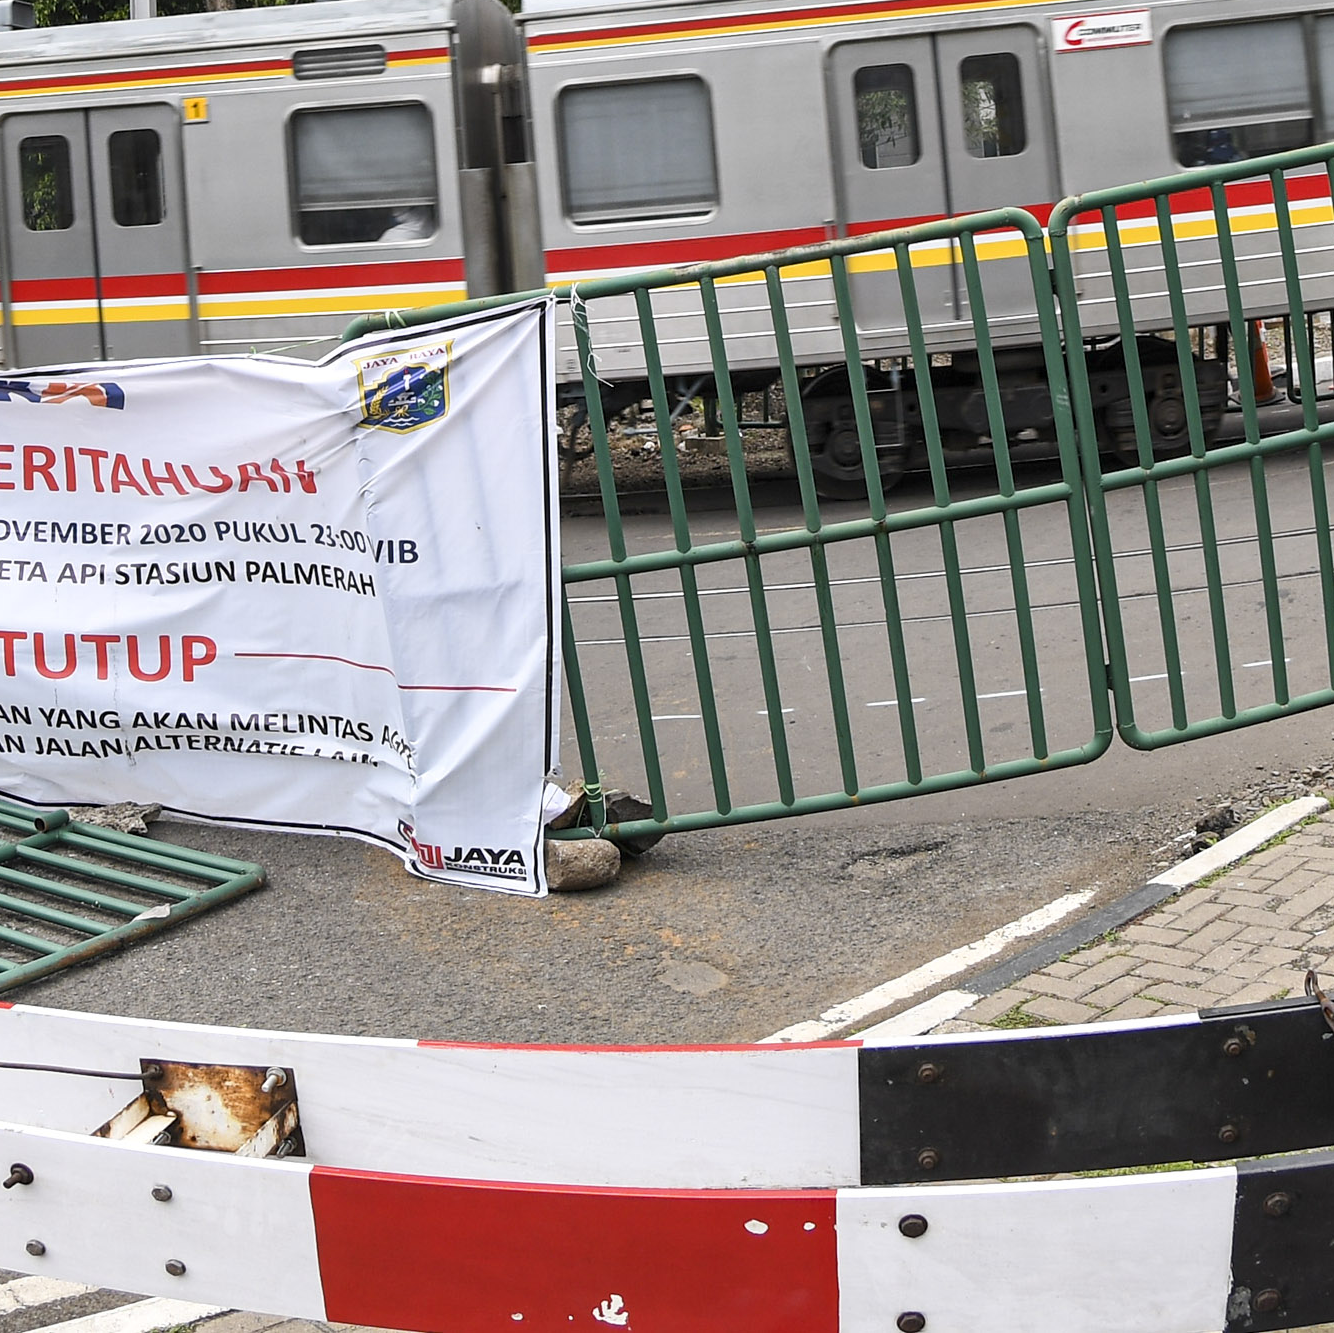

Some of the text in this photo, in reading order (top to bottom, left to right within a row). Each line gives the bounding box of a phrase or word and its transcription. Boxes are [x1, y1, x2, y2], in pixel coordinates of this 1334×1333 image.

[190, 101, 201, 118] 1
[363, 357, 399, 370] JAYA
[139, 522, 207, 545] 2020
[214, 520, 307, 544] PUKUL
[309, 523, 367, 554] 23:00
[56, 562, 105, 585] API
[114, 561, 236, 585] STASIUN
[245, 561, 376, 598] PALMERAH
[38, 706, 122, 730] YANG
[131, 711, 219, 731] AKAN
[230, 713, 374, 743] MELINTAS
[35, 736, 124, 759] JALAN
[444, 847, 526, 867] JAYA
[445, 862, 528, 876] KONSTRUKSI
